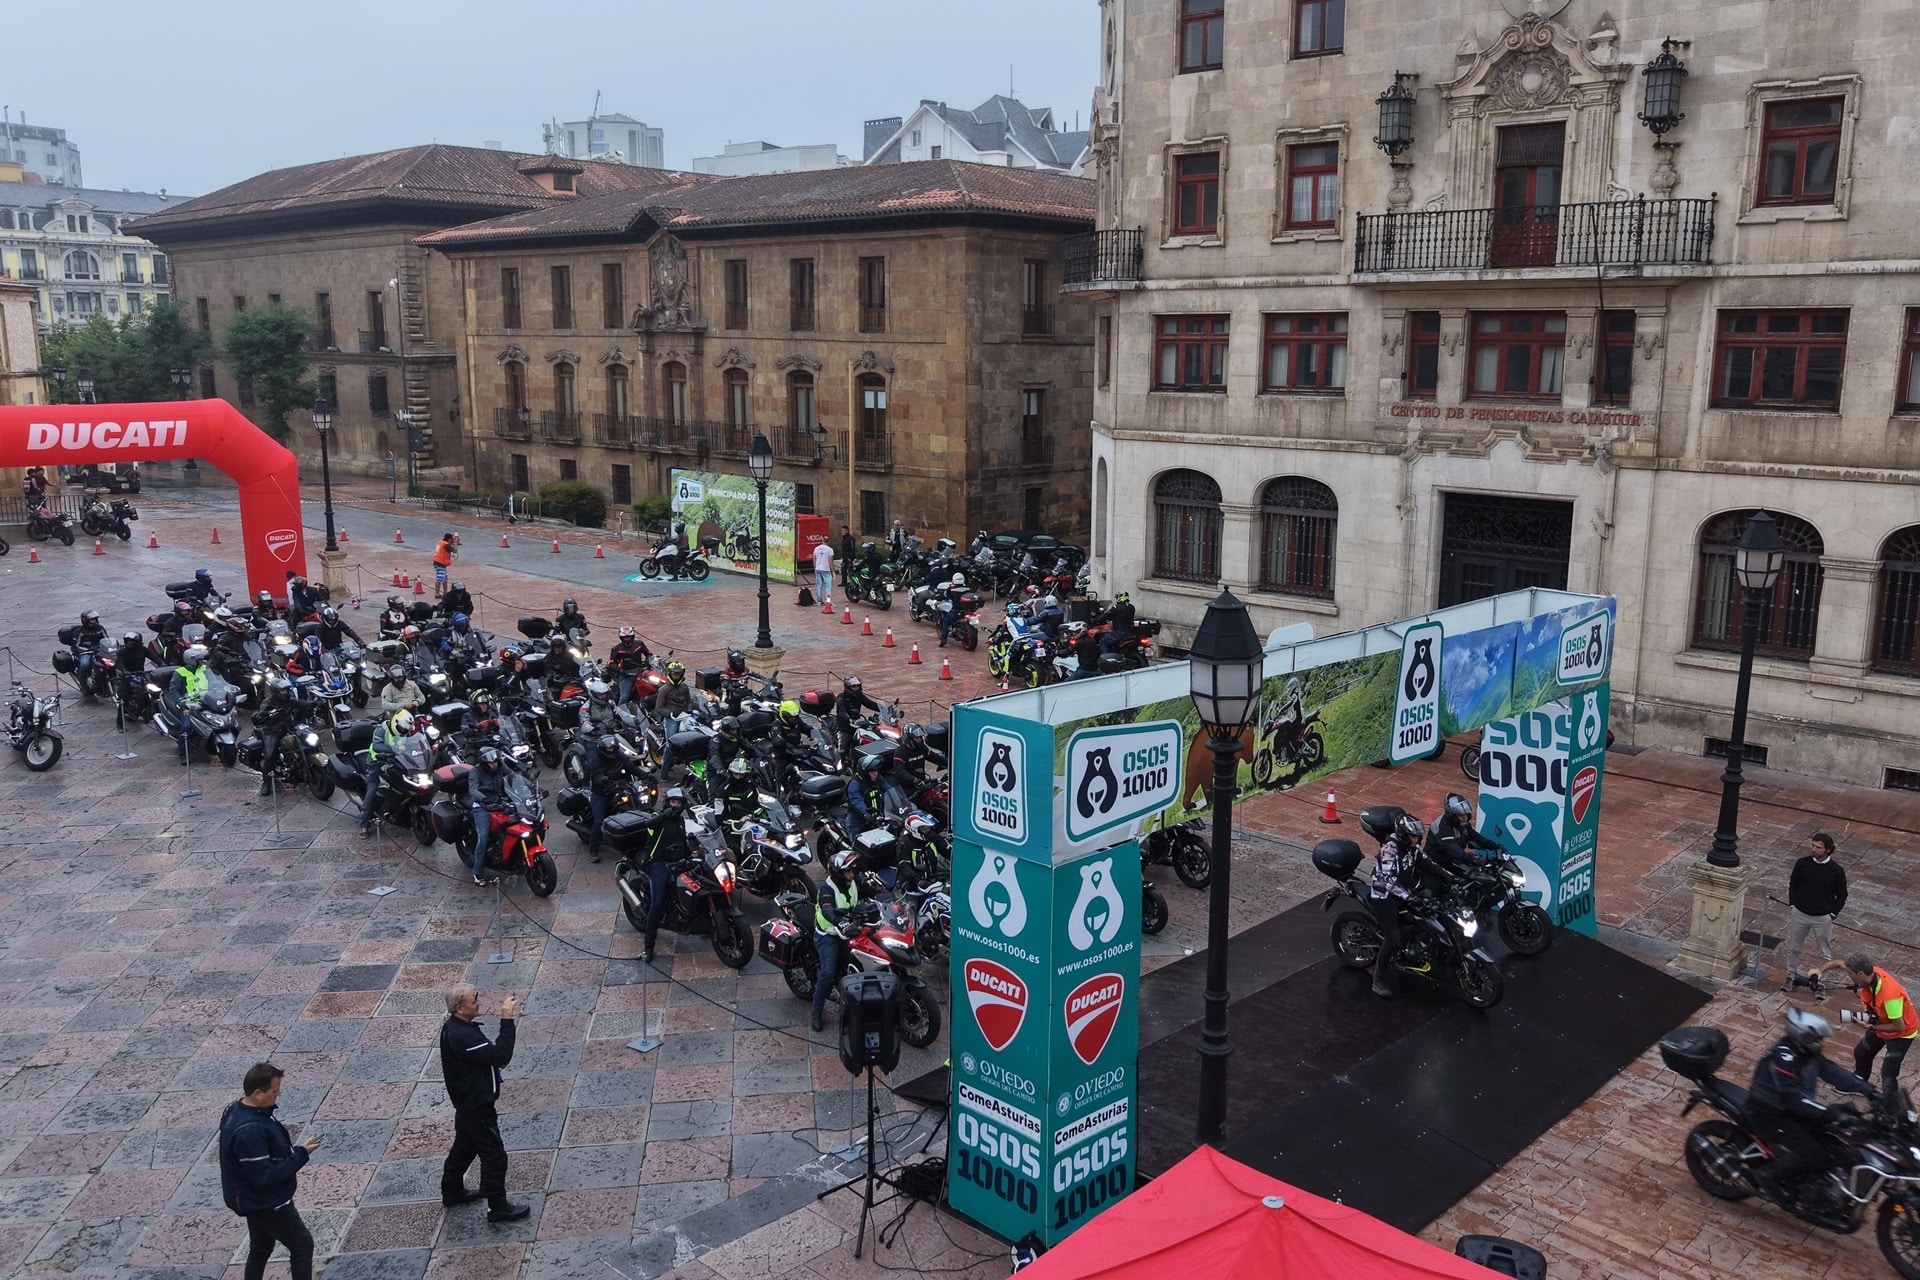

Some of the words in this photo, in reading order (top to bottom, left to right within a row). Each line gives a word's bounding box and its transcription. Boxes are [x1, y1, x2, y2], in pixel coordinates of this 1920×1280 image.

[1391, 404, 1440, 418] CENTRO
[1445, 407, 1464, 419] DE
[1470, 408, 1563, 424] PENSIONISTAS
[1570, 412, 1641, 427] CAJASTUR
[27, 420, 187, 450] DUCATI
[708, 488, 746, 501] PRINCIPADO
[1565, 633, 1587, 652] OSOS
[1563, 650, 1585, 670] 1000
[1399, 701, 1434, 729] OSOS
[1398, 723, 1433, 749] 1000
[1480, 711, 1572, 752] SOS
[1123, 742, 1169, 774] OSOS
[1122, 766, 1168, 798] 1000
[1573, 772, 1596, 789] DUCATI
[981, 806, 1017, 830] 1000
[982, 790, 1018, 814] OSOS
[1570, 828, 1593, 848] OVIEDO
[1561, 851, 1592, 873] ComeAsturias
[1558, 869, 1592, 905] OSOS
[1557, 893, 1592, 927] 1000
[958, 927, 1040, 965] www.osos1000.es
[1057, 942, 1134, 976] www.osos1000.es
[970, 967, 1021, 1000] DUCATI
[1070, 982, 1119, 1014] DUCATI
[980, 1060, 1036, 1096] OVIEDO
[980, 1074, 1001, 1089] ORIGEN
[1001, 1083, 1012, 1094] DEL
[1012, 1088, 1036, 1105] CAMINO
[1074, 1066, 1125, 1101] OVIEDO
[959, 1084, 1041, 1134] ComeAsturias
[1074, 1096, 1093, 1110] ORIGEN
[1093, 1091, 1103, 1100] DEL
[1103, 1081, 1124, 1096] CAMINO
[1055, 1102, 1128, 1145] ComeAsturias
[957, 1112, 1040, 1179] OSOS
[1053, 1126, 1128, 1193] OSOS
[957, 1148, 1038, 1215] 1000
[1054, 1162, 1127, 1230] 1000
